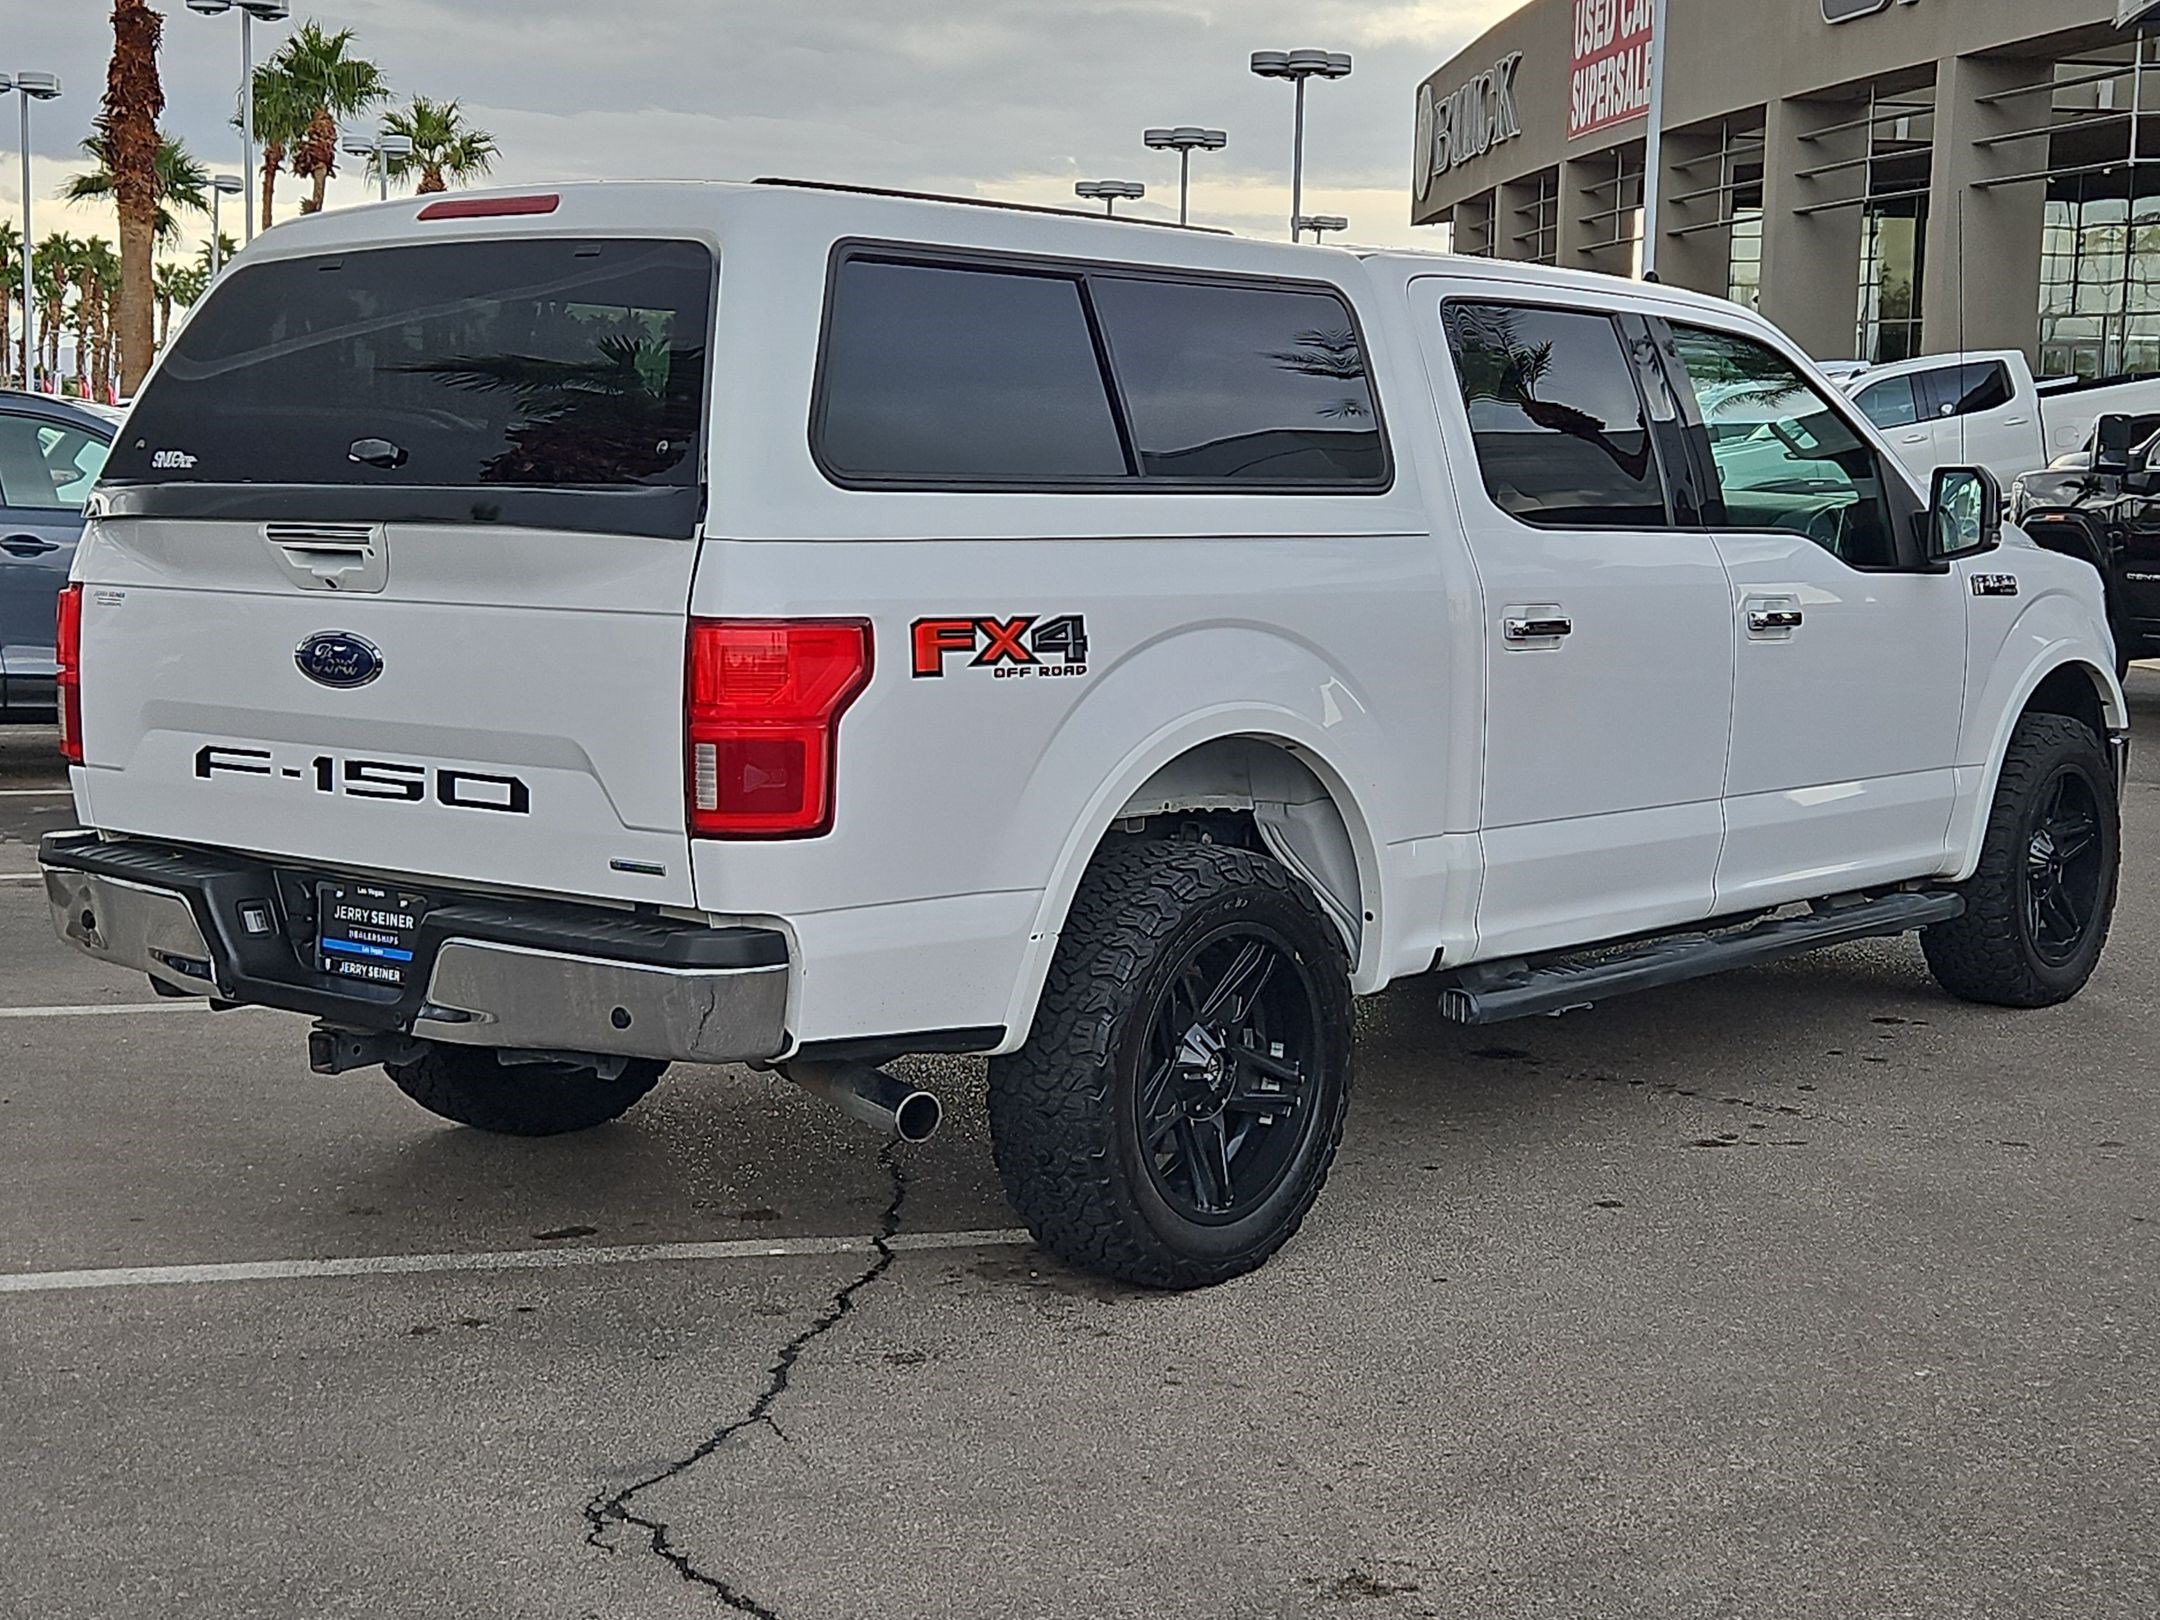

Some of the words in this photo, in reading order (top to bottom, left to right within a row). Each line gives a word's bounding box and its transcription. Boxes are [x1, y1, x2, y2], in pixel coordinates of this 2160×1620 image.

[1574, 0, 1616, 60] USED
[1432, 50, 1523, 177] BUICK
[1571, 41, 1653, 131] SUPERSALE
[910, 614, 1088, 679] FX4
[993, 667, 1031, 679] OFF
[1039, 665, 1087, 678] ROAD
[195, 745, 530, 815] F-150
[334, 905, 370, 922] JERRY
[371, 910, 414, 929] SEINER
[348, 930, 399, 945] DEALERSHIPS
[339, 961, 368, 977] JERRY
[368, 966, 400, 982] SEINER
